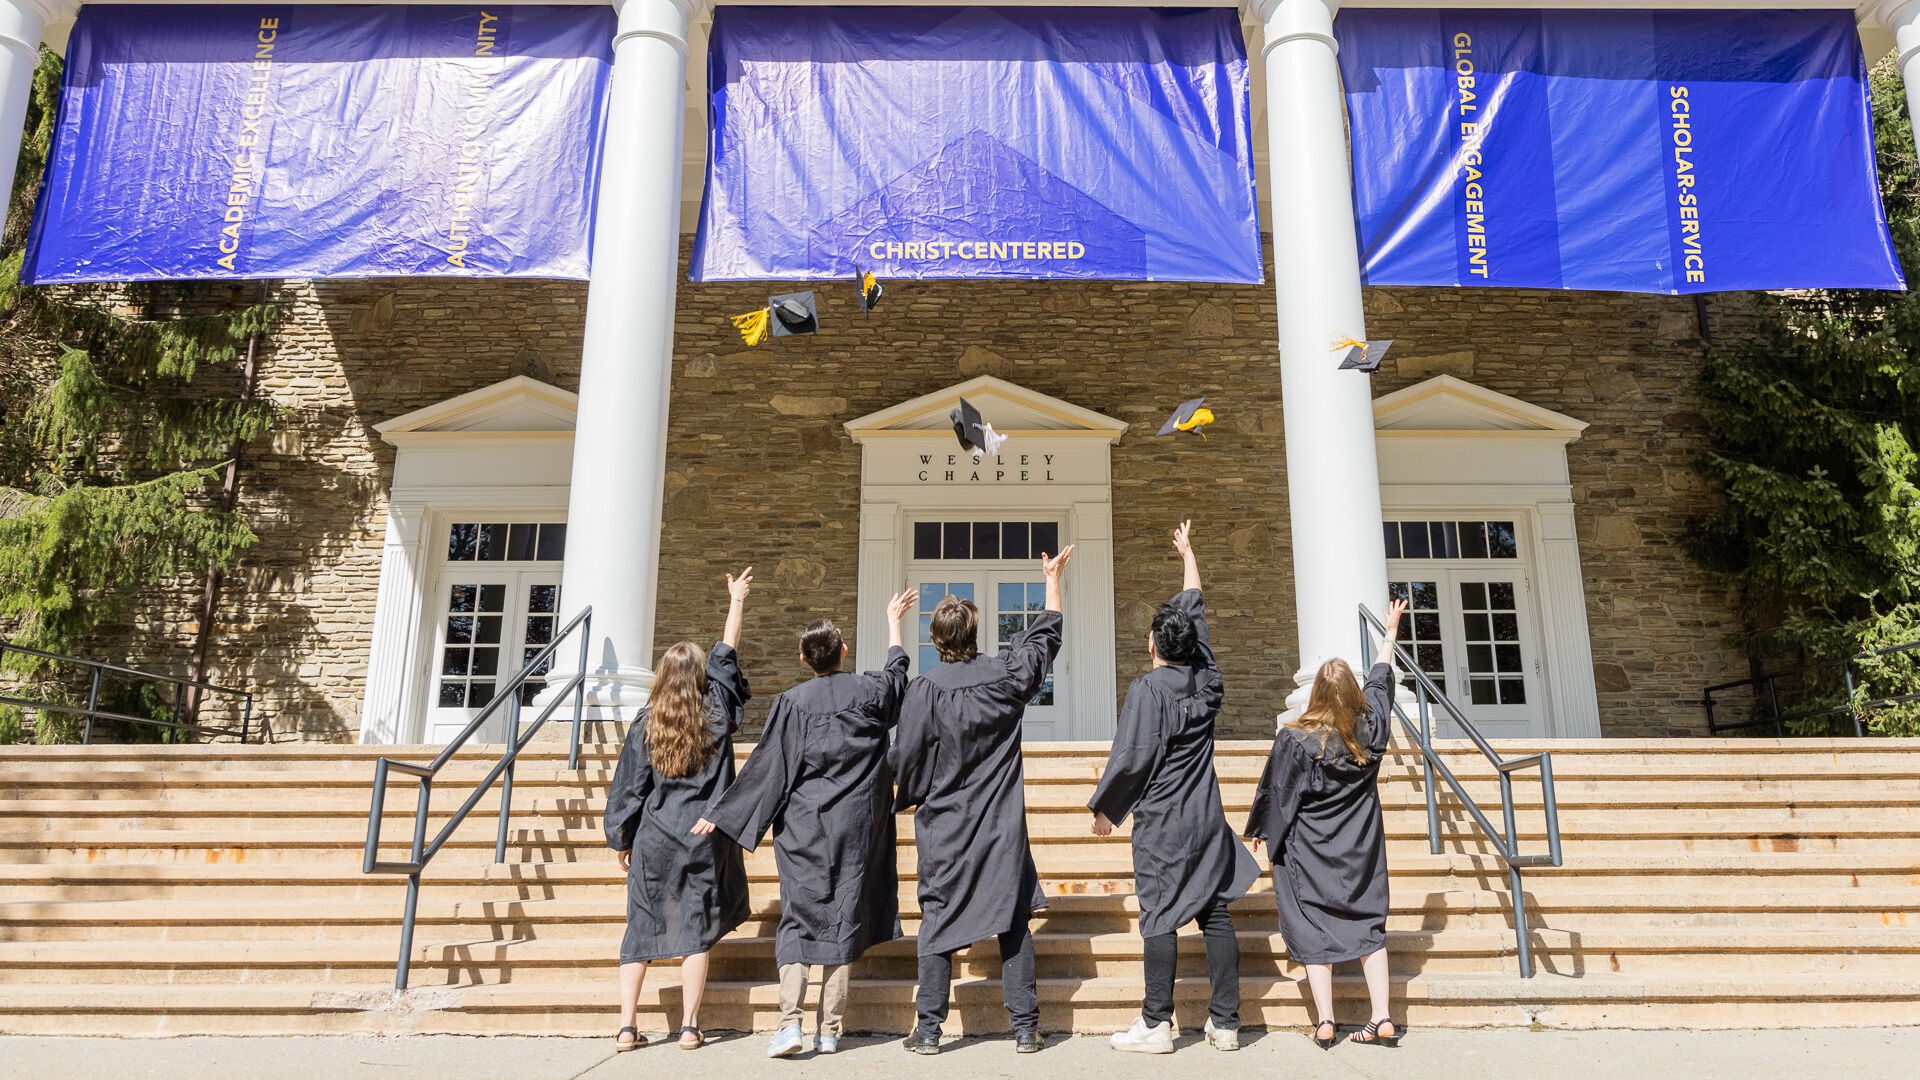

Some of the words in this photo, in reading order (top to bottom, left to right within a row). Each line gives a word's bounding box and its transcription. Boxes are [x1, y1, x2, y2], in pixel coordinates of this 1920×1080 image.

[464, 11, 498, 138] COMMNITY
[1453, 32, 1477, 116] GLOBAL
[217, 152, 255, 271] ACADEMIC
[239, 17, 279, 147] EXCELLENCE
[1670, 86, 1705, 283] SCHOLAR-SERVICE
[869, 241, 1086, 260] CHRIST-CENTERED
[1461, 122, 1488, 279] ENGAGEMENT
[918, 471, 1054, 481] CHAPEL
[919, 455, 1054, 465] WESLEY
